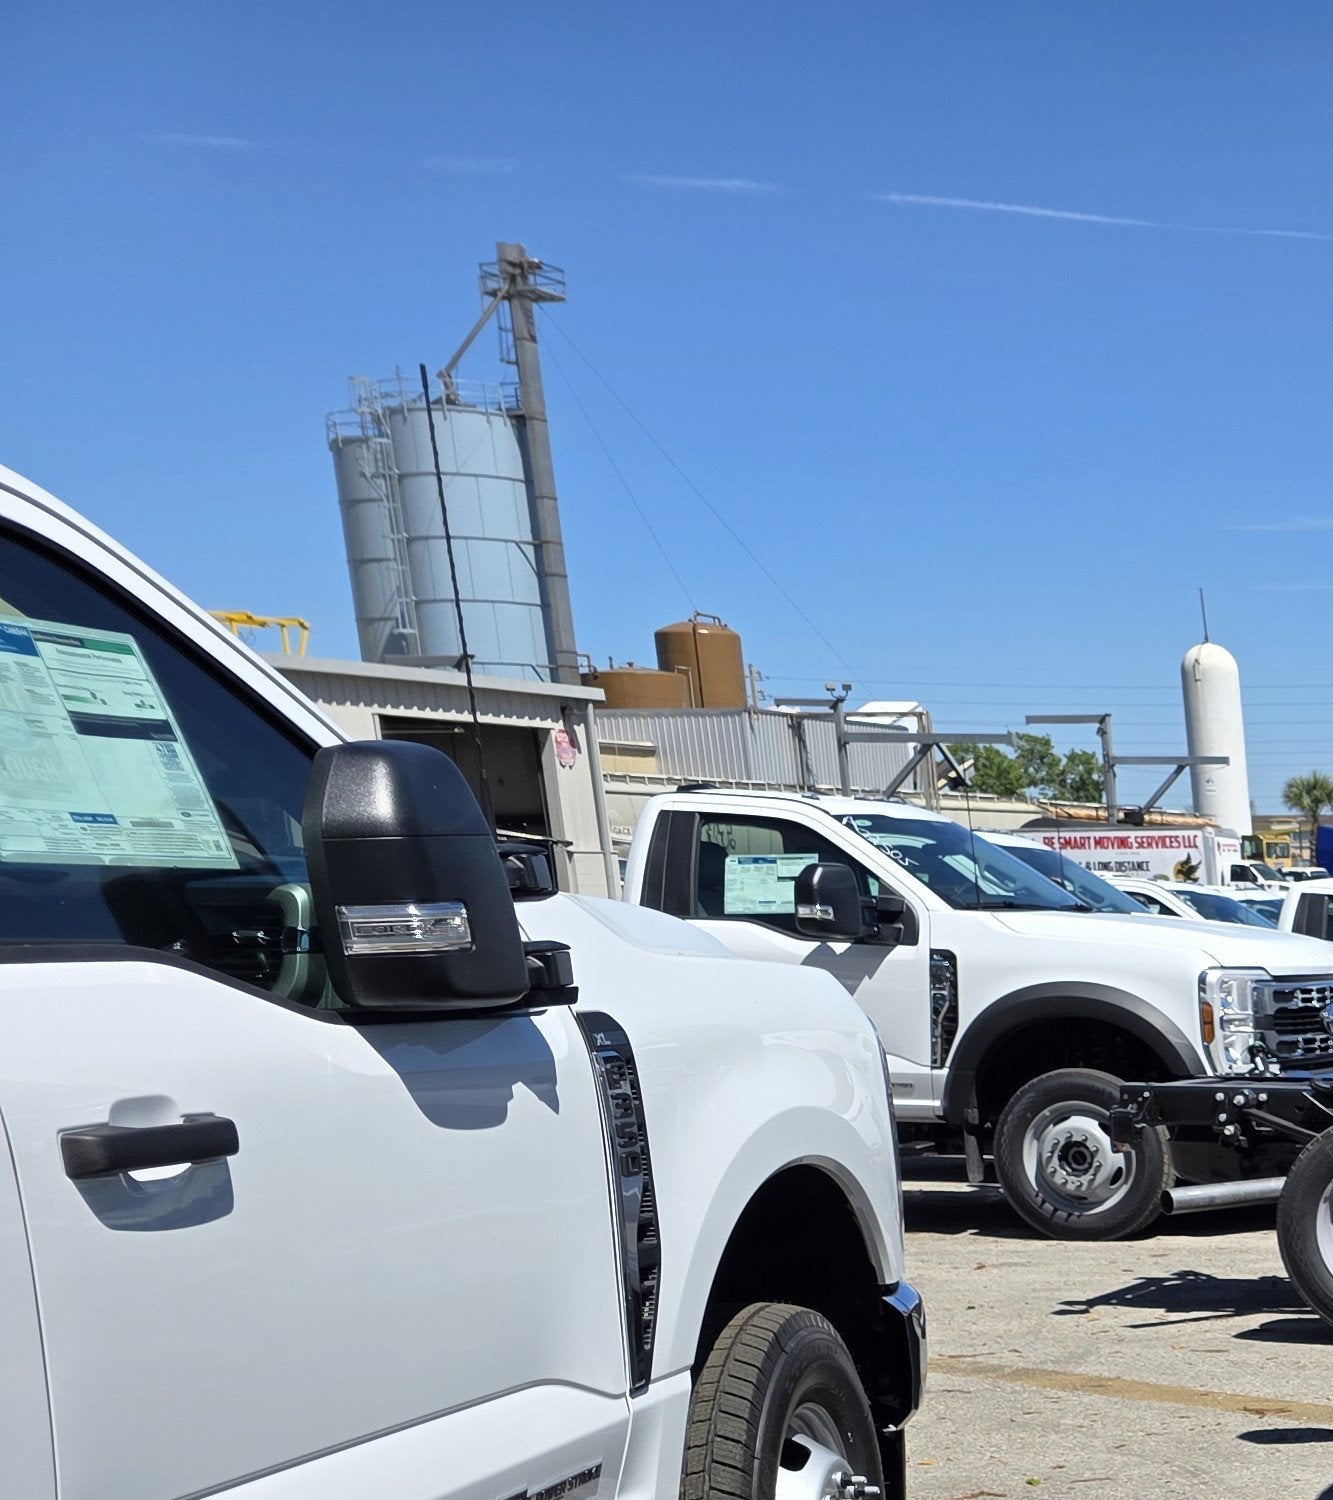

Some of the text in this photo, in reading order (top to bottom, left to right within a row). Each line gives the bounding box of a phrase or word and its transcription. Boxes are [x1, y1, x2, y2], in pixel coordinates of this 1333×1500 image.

[1058, 836, 1091, 850] SMART
[1093, 836, 1132, 850] MOVING
[1135, 835, 1182, 849] SERVICES
[1183, 834, 1199, 849] LLC
[1093, 861, 1114, 872] LONG
[1115, 860, 1151, 872] DISTANCE
[593, 1032, 611, 1047] XL
